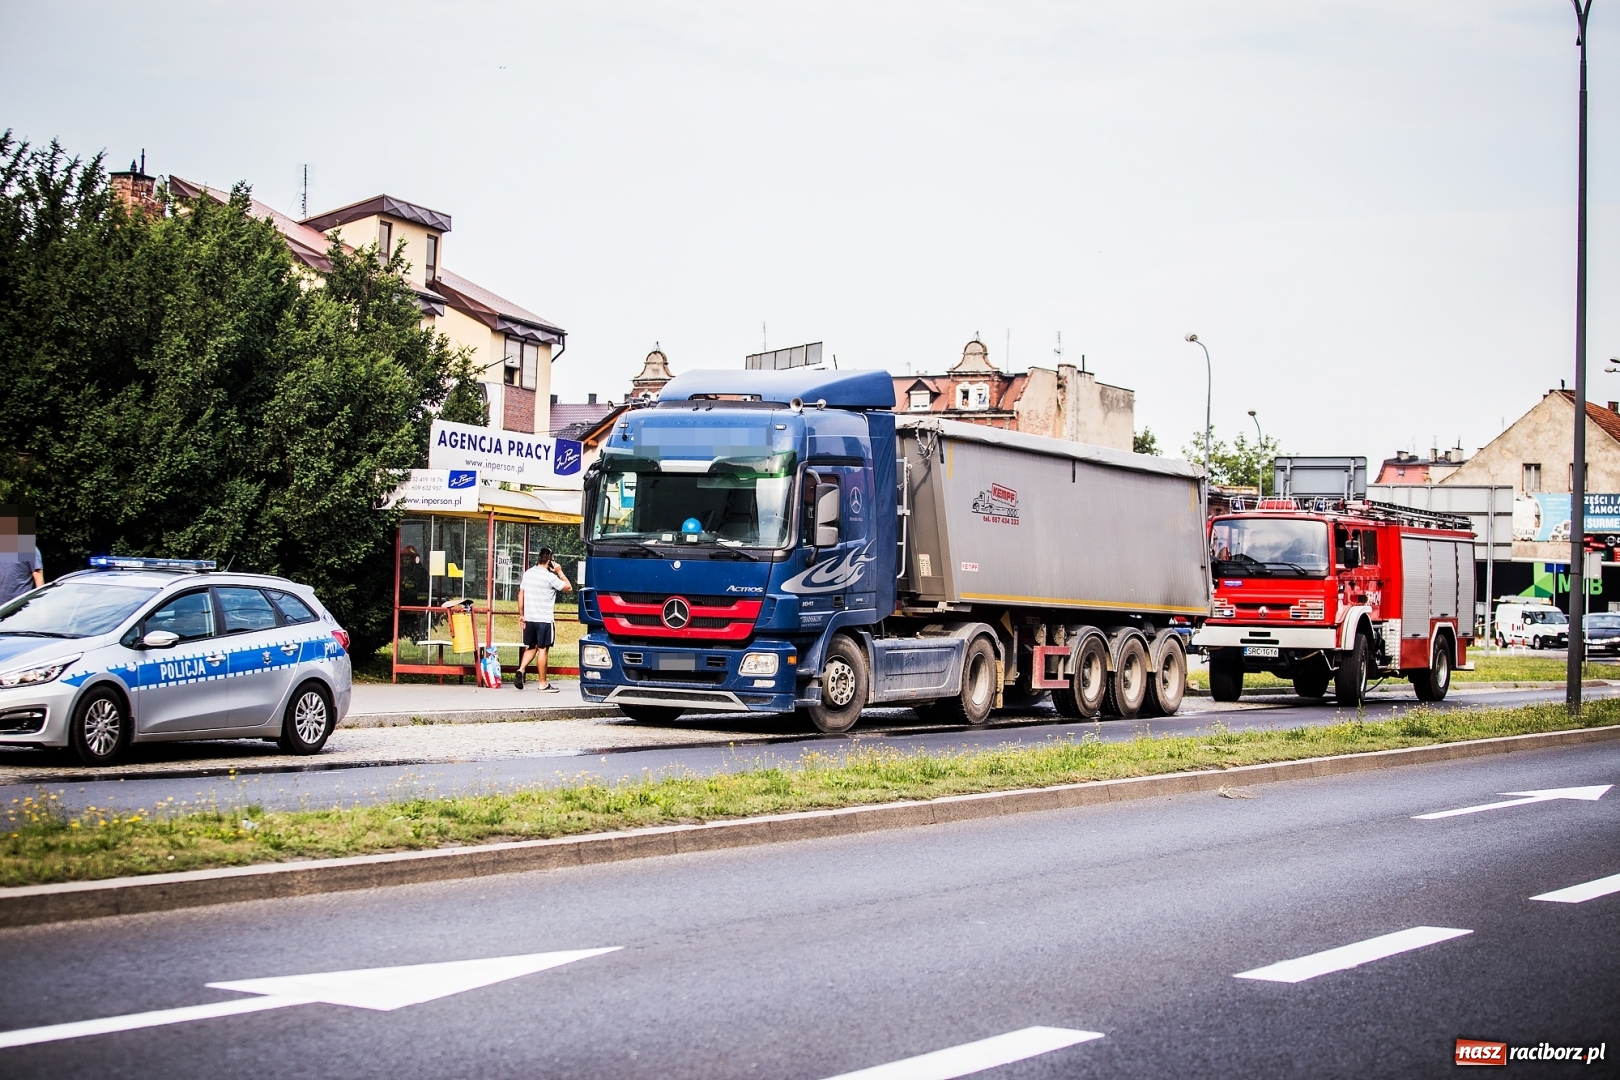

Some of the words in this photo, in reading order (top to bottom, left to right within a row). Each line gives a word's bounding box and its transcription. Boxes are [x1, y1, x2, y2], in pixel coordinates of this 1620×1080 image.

[437, 430, 503, 455] AGENCJA
[508, 439, 552, 461] PRACY
[465, 458, 525, 475] www.inperson.pl
[405, 496, 462, 508] ww.inperson.pl
[992, 486, 1015, 502] KEMPF
[1584, 495, 1608, 506] ZĘŚCI
[983, 515, 991, 523] tel.
[160, 659, 206, 680] POLICJA
